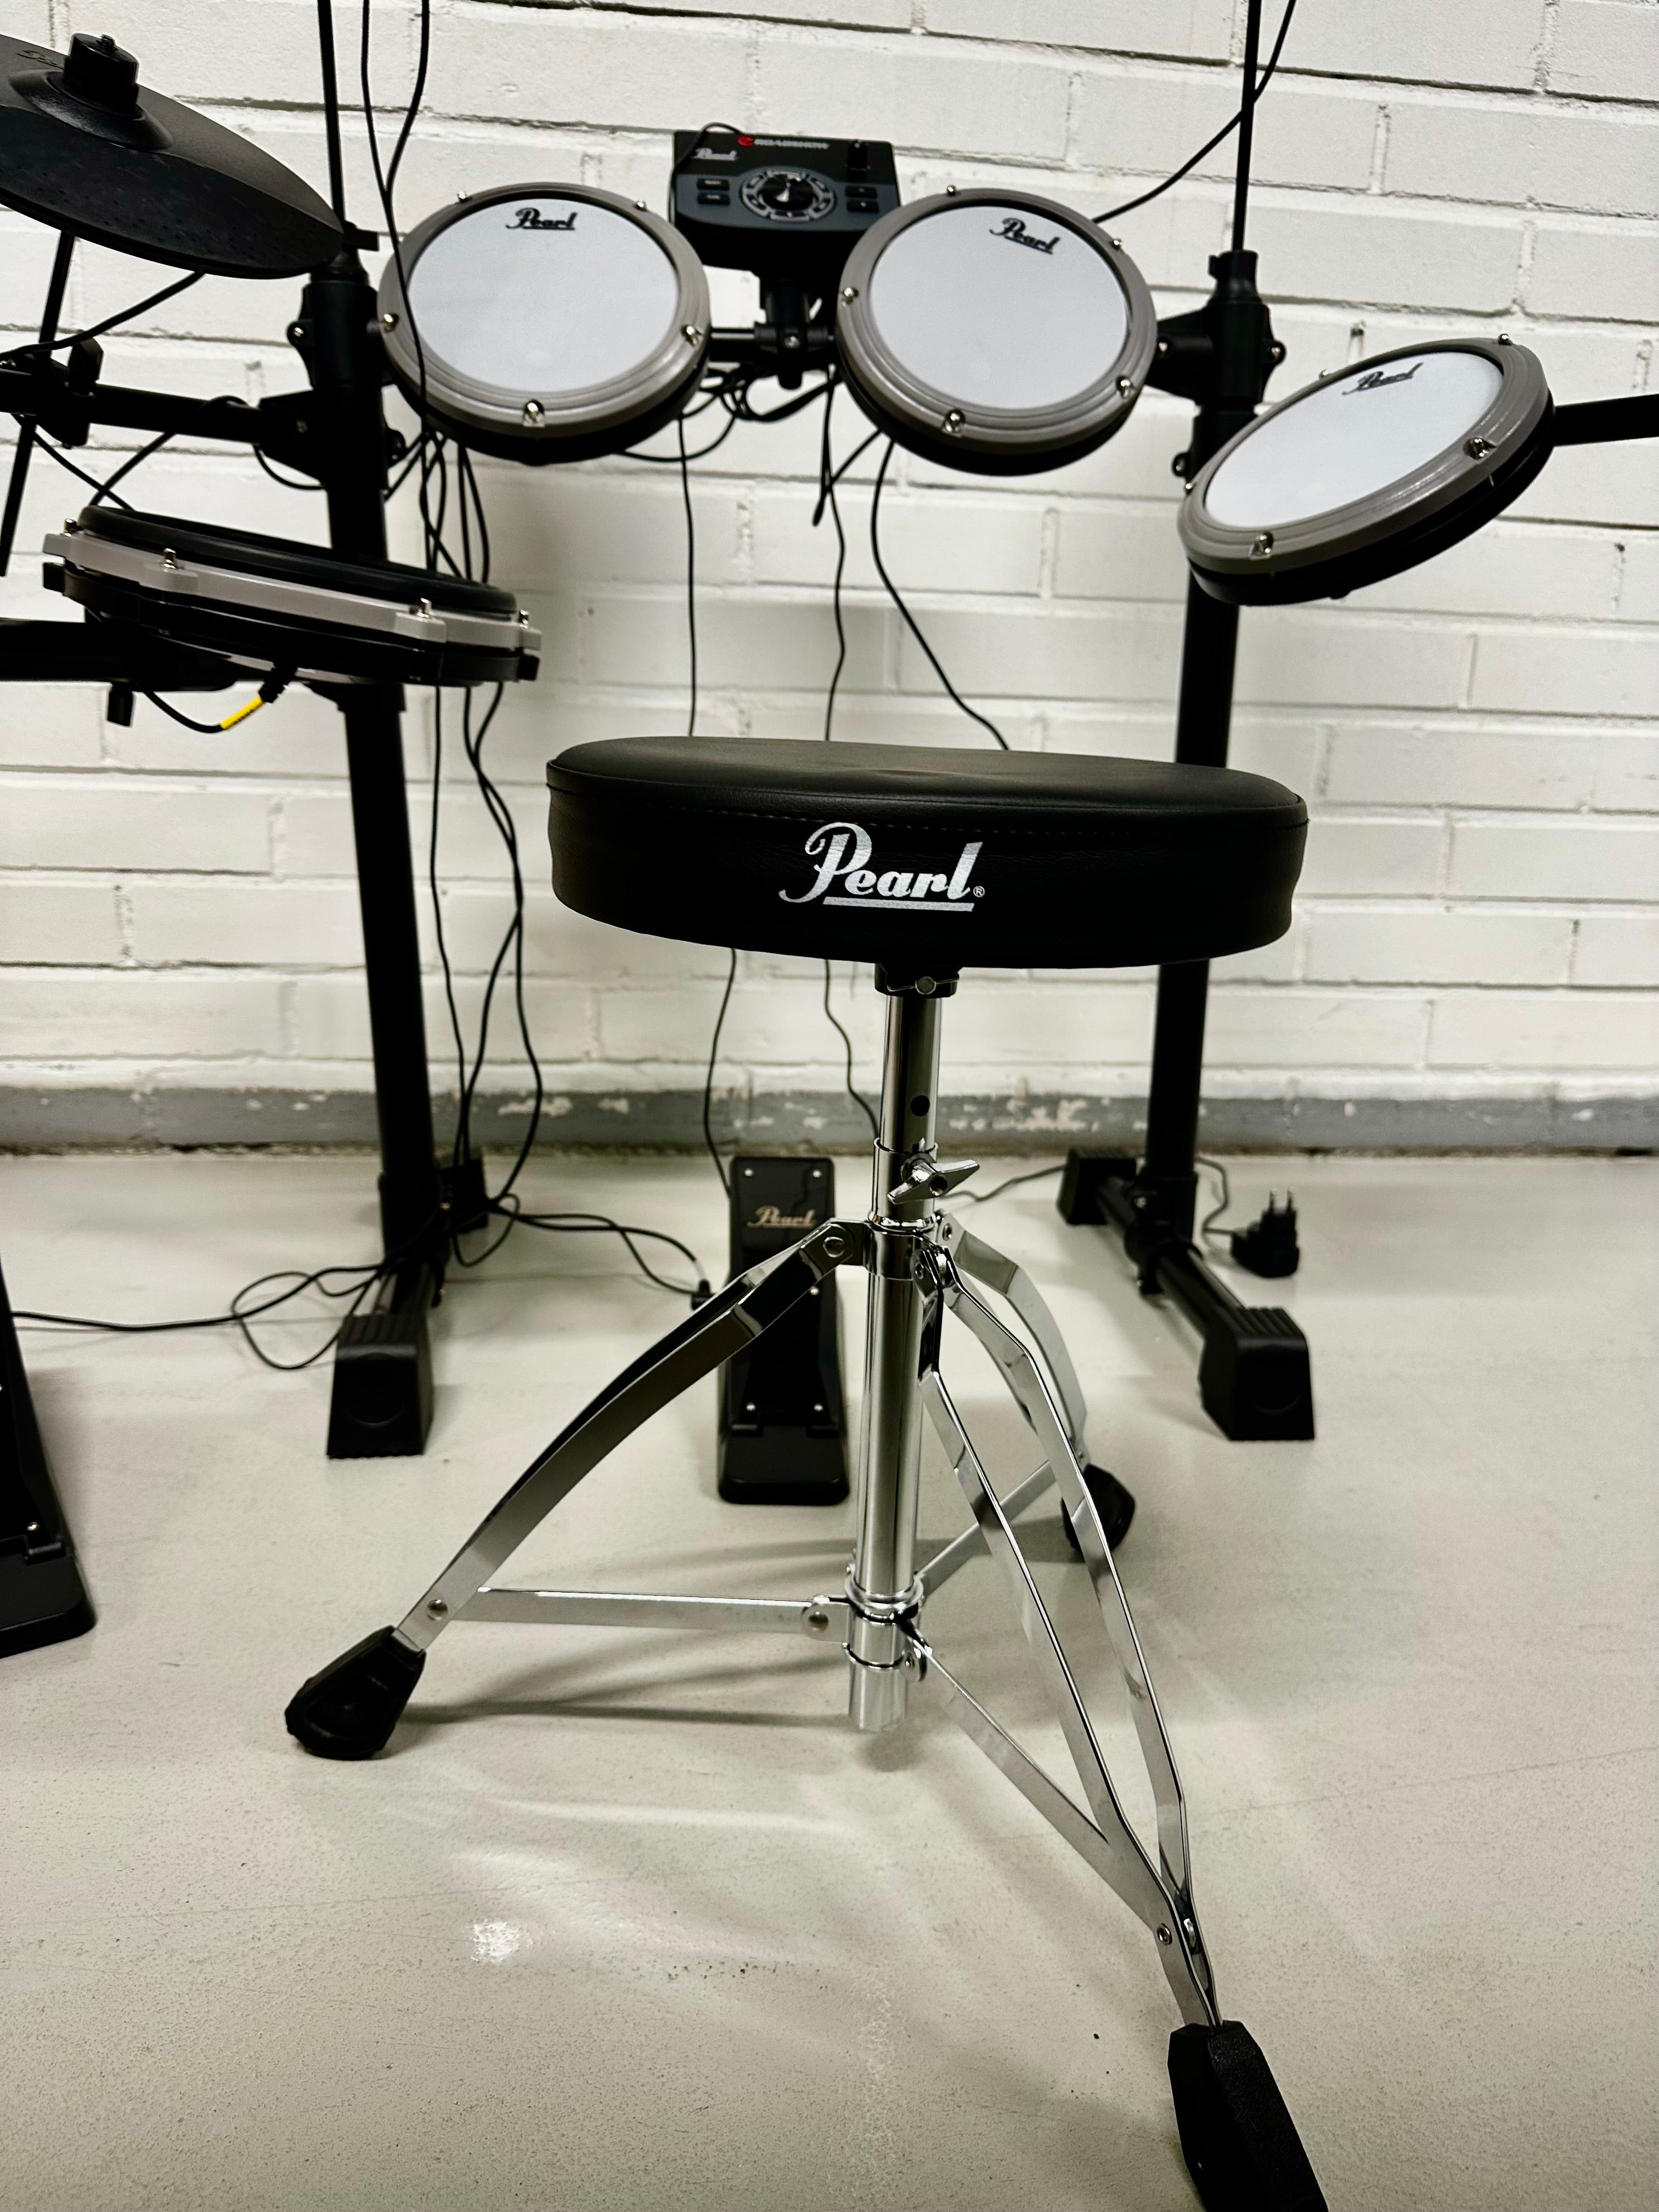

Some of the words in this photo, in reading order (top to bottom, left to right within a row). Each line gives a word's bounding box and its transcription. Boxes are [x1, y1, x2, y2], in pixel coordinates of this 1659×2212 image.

[505, 207, 578, 230] Pearl
[989, 218, 1061, 255] Pearl
[1342, 362, 1424, 396] Pearl
[746, 1205, 815, 1228] Pearl
